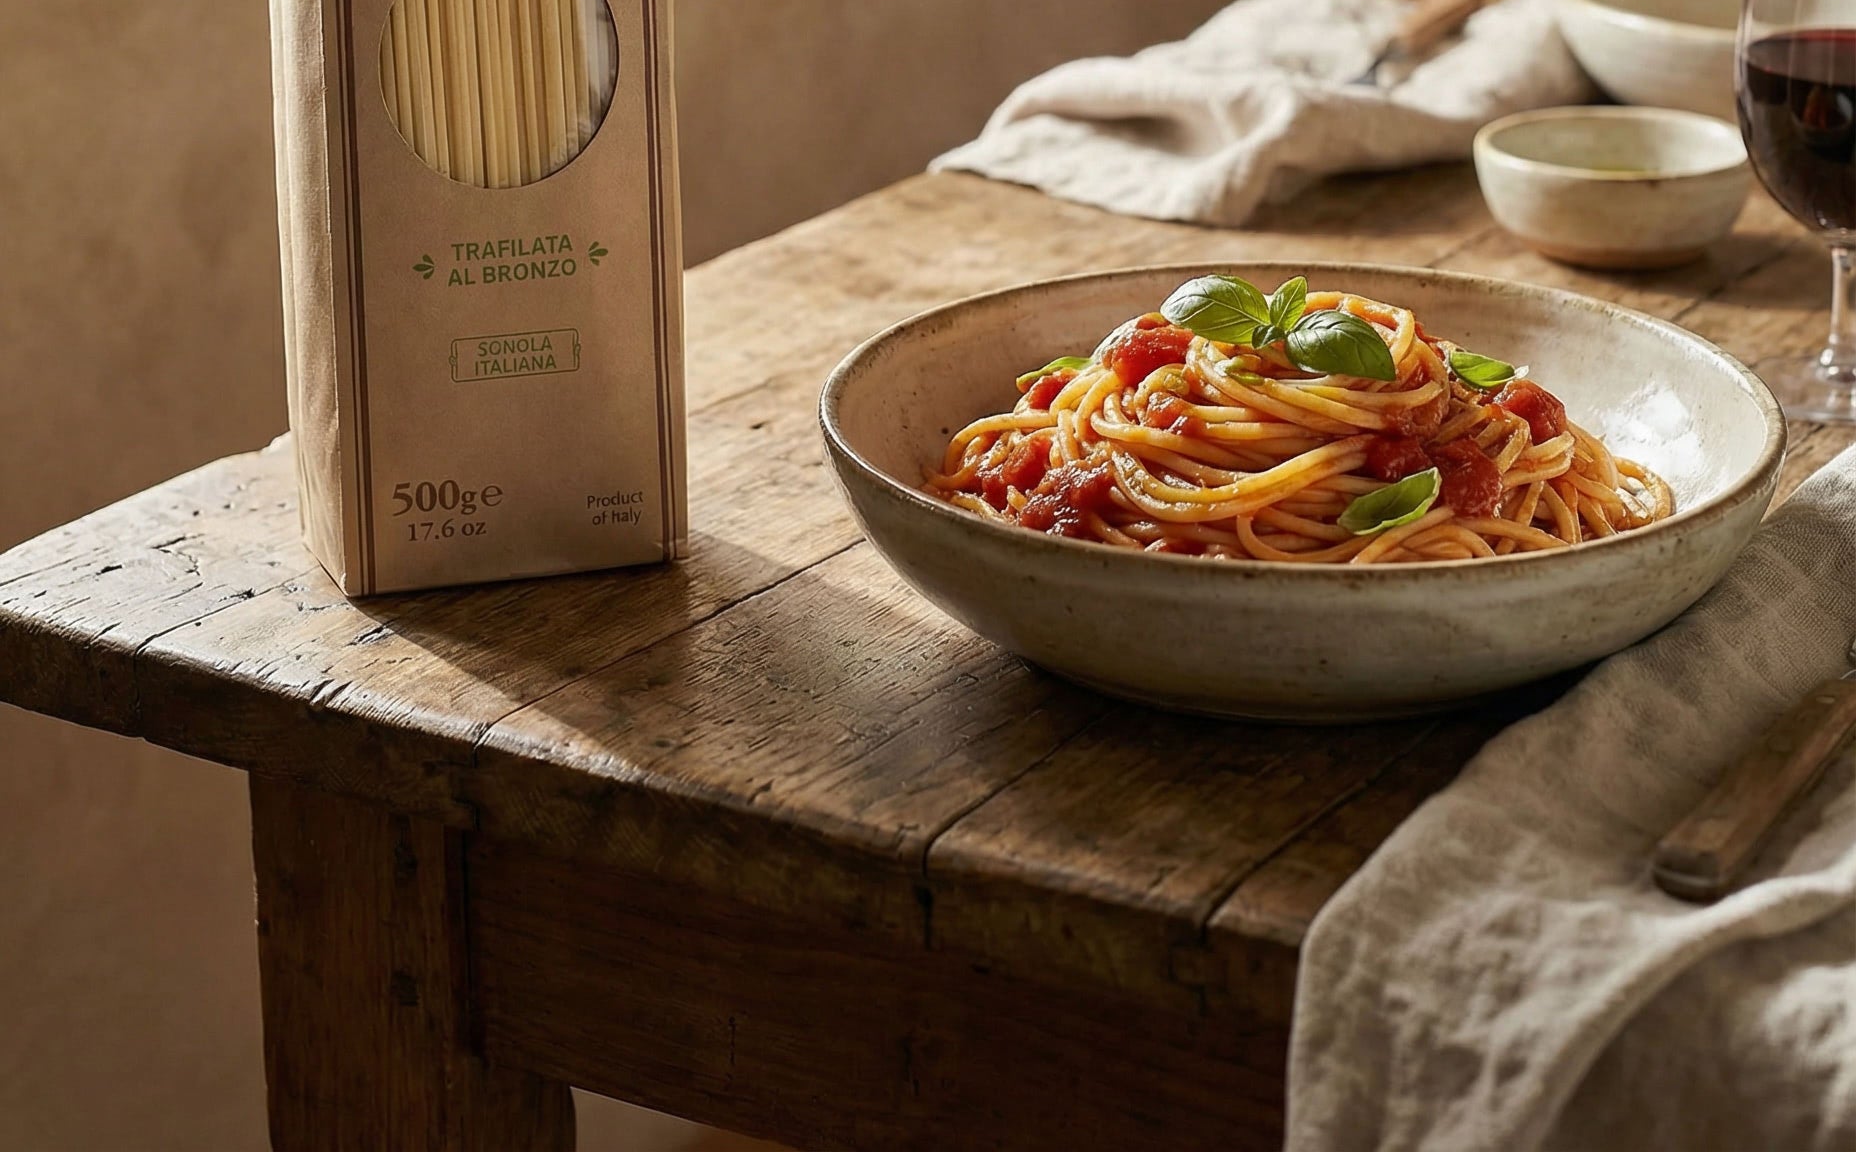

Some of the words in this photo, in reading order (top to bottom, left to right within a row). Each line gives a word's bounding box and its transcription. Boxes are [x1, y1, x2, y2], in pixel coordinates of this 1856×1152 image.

[451, 234, 573, 261] TRAFILATA
[448, 269, 476, 286] AL
[482, 259, 577, 284] BRONZO
[475, 354, 557, 376] ITALIANA
[587, 490, 644, 509] Product
[592, 510, 607, 525] of
[408, 518, 455, 541] 17.6
[461, 522, 487, 536] oz
